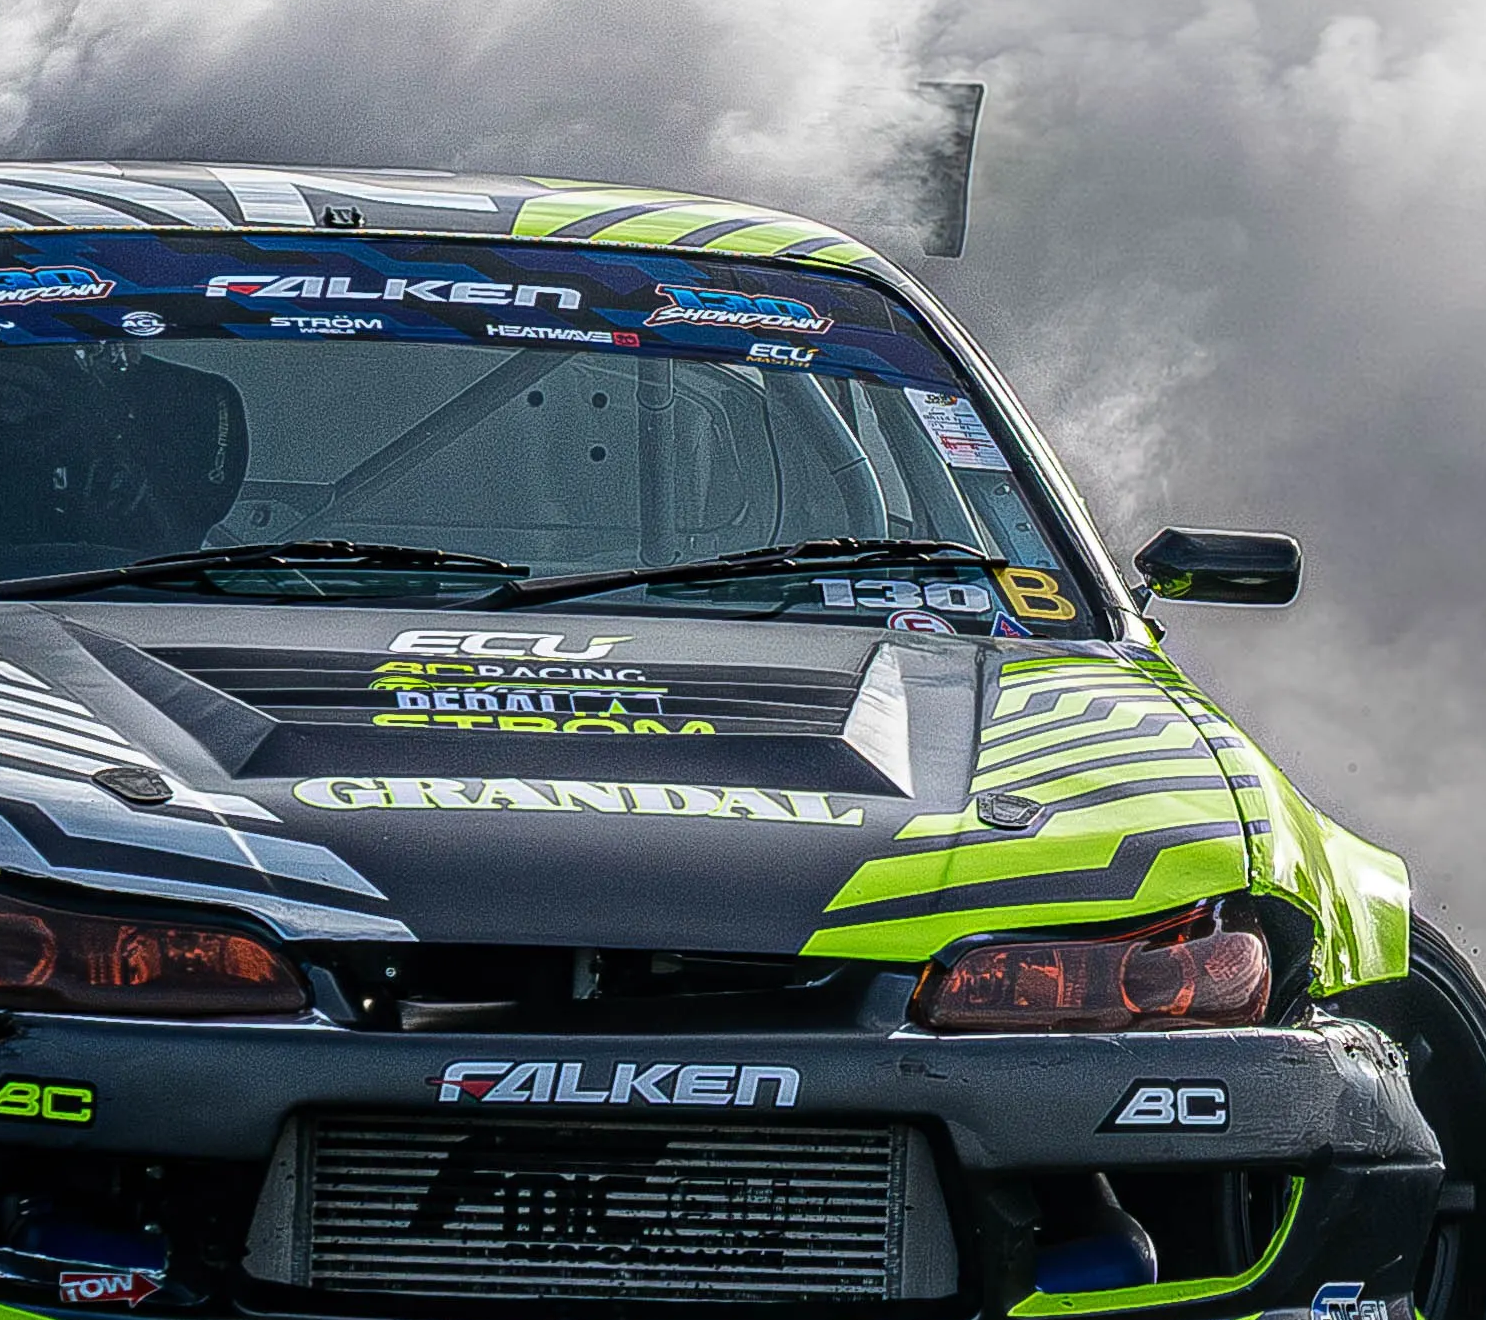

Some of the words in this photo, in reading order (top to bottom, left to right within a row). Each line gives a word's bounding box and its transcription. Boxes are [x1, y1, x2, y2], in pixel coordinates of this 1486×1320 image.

[205, 275, 581, 309] FALKEN
[121, 319, 166, 329] ACL
[486, 324, 613, 344] HEATWAVE
[657, 307, 825, 331] SHOWDOWN
[749, 343, 819, 362] ECU
[811, 578, 991, 613] 130
[992, 567, 1076, 620] B
[388, 630, 635, 659] ECU
[293, 776, 864, 826] GRANDAL
[438, 1062, 800, 1107] FALKEN
[1114, 1087, 1227, 1128] BC
[60, 1275, 132, 1302] TOW
